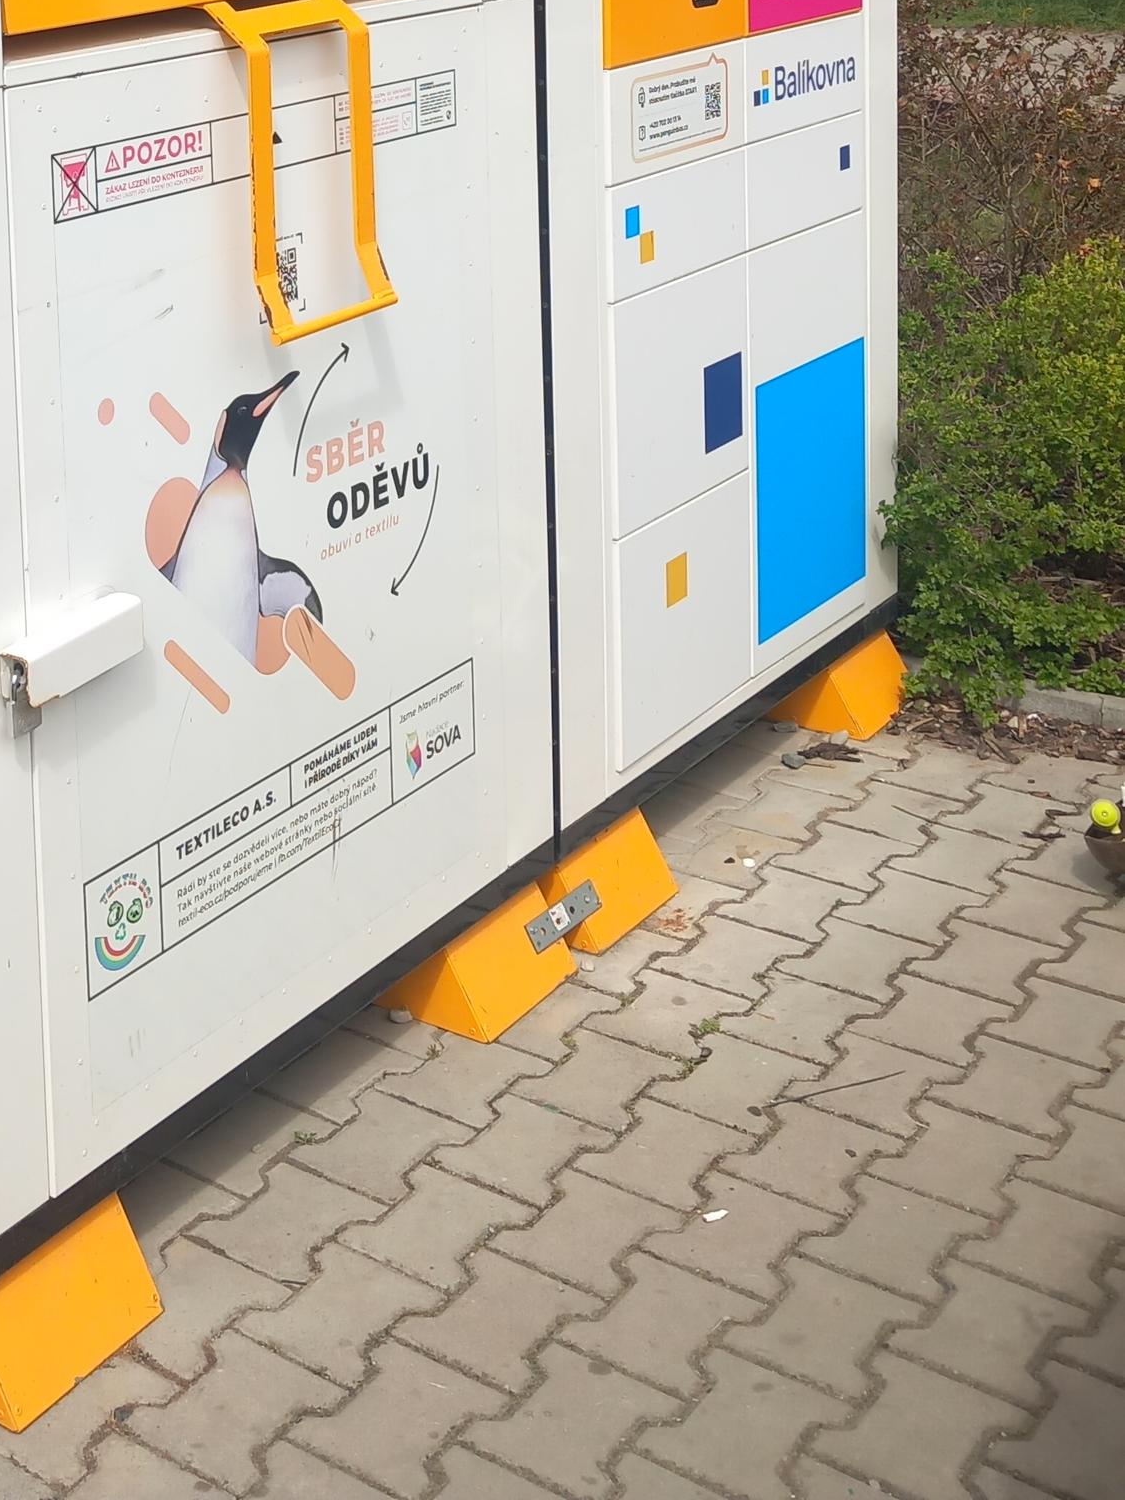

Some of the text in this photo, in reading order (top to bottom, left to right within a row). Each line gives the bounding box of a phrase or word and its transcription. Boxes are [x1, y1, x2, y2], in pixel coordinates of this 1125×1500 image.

[775, 56, 856, 101] Balíkovna
[122, 130, 203, 169] POZOR!
[105, 183, 129, 195] ZÁKAZ
[128, 177, 150, 190] LEZENÍ
[305, 418, 386, 484] SBĚR
[326, 442, 431, 530] ODĚVŮ
[320, 514, 400, 561] obuvi a textilu
[303, 723, 378, 775] POMÁHÁME LIDEM
[308, 757, 342, 787] PŘÍRODĚ
[342, 746, 361, 767] DÍKY
[361, 737, 378, 755] VÁM
[426, 724, 462, 760] SOVA
[175, 790, 277, 861] TEXTILECO A.S.
[176, 881, 196, 899] Rádi
[197, 872, 208, 887] by
[222, 858, 232, 871] se
[289, 812, 309, 829] nebo
[309, 798, 329, 816] máte
[329, 783, 351, 805] dobrý
[177, 895, 193, 913] Tak
[253, 840, 283, 864] webové
[284, 821, 313, 846] stránky
[313, 808, 334, 827] nebo
